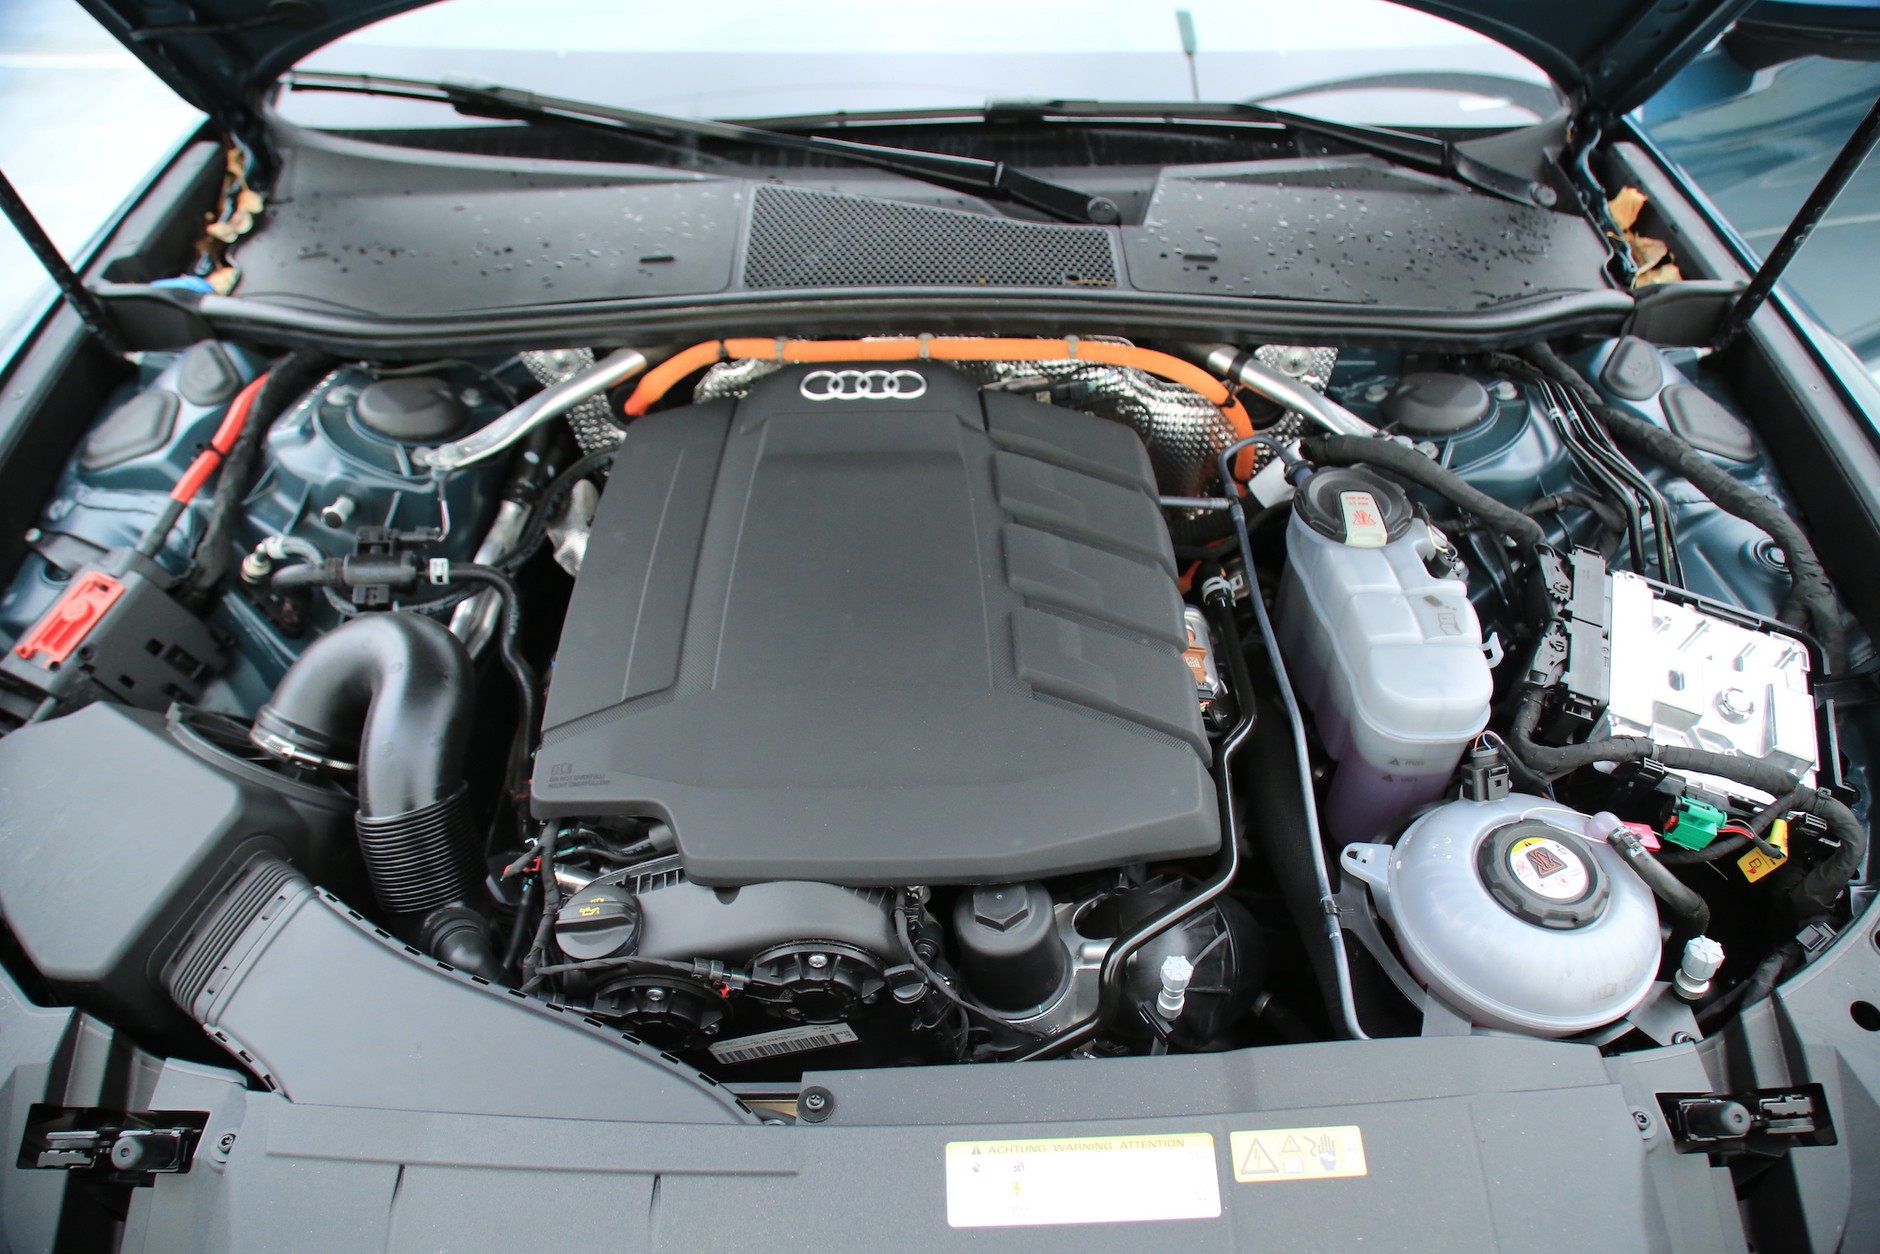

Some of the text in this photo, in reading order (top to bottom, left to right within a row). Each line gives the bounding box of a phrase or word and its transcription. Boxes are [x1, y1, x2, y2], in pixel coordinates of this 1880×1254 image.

[988, 1139, 1185, 1154] ACHTUNG WARNING ATTENTION
